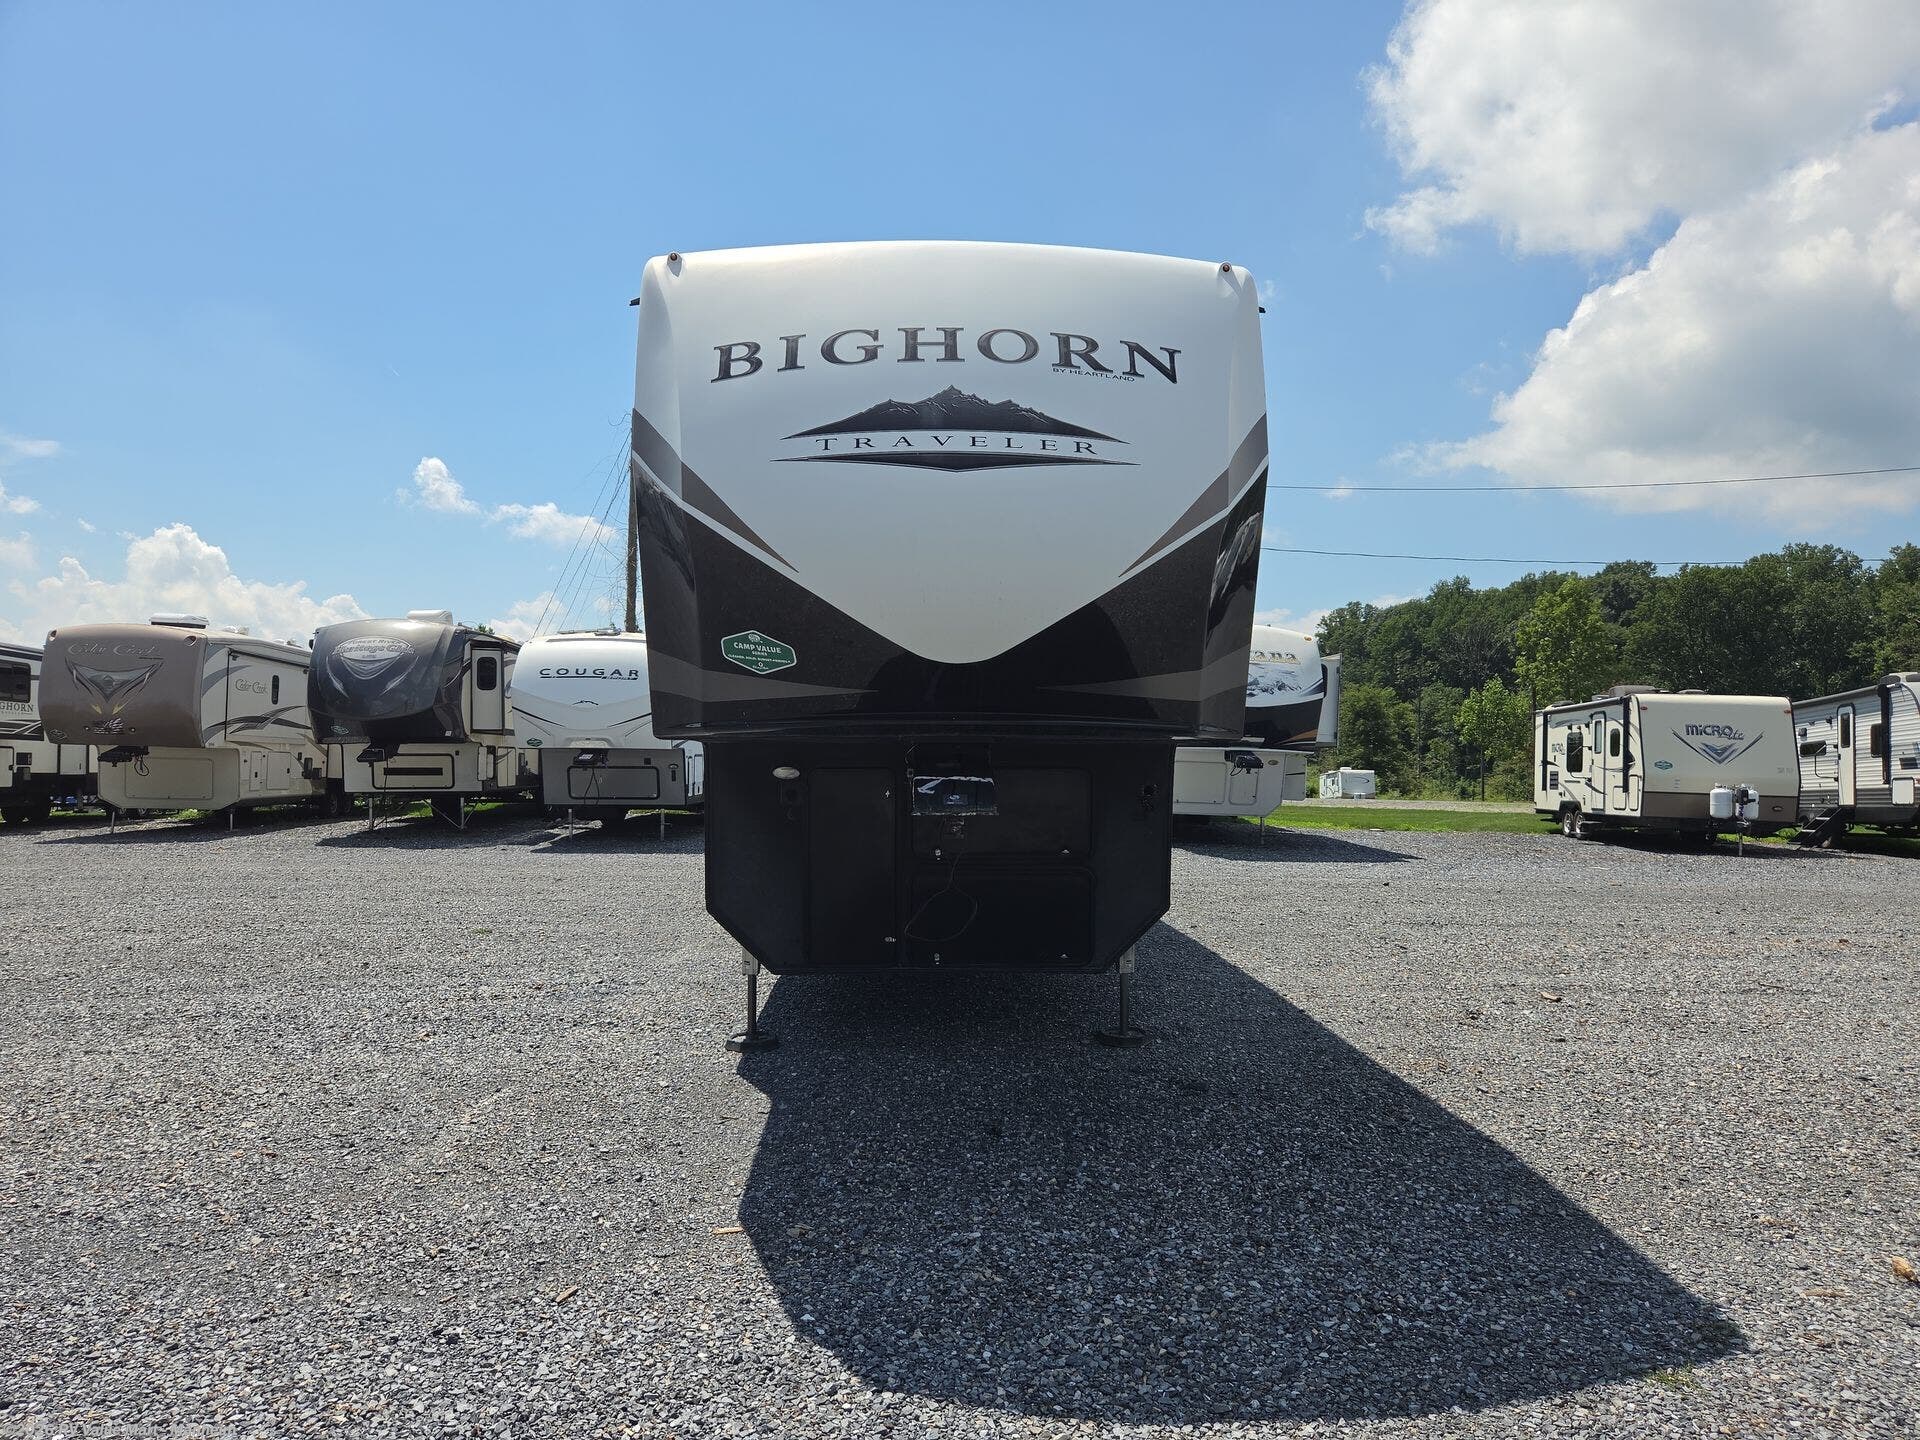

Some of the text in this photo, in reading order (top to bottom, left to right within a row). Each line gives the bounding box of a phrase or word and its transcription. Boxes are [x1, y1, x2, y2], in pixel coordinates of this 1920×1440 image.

[710, 327, 1182, 384] BIGHORN
[1069, 369, 1135, 382] HEARTLAND
[816, 435, 1098, 455] TRAVELER
[733, 642, 782, 654] CAMP VALUE
[539, 667, 640, 678] COUGAR
